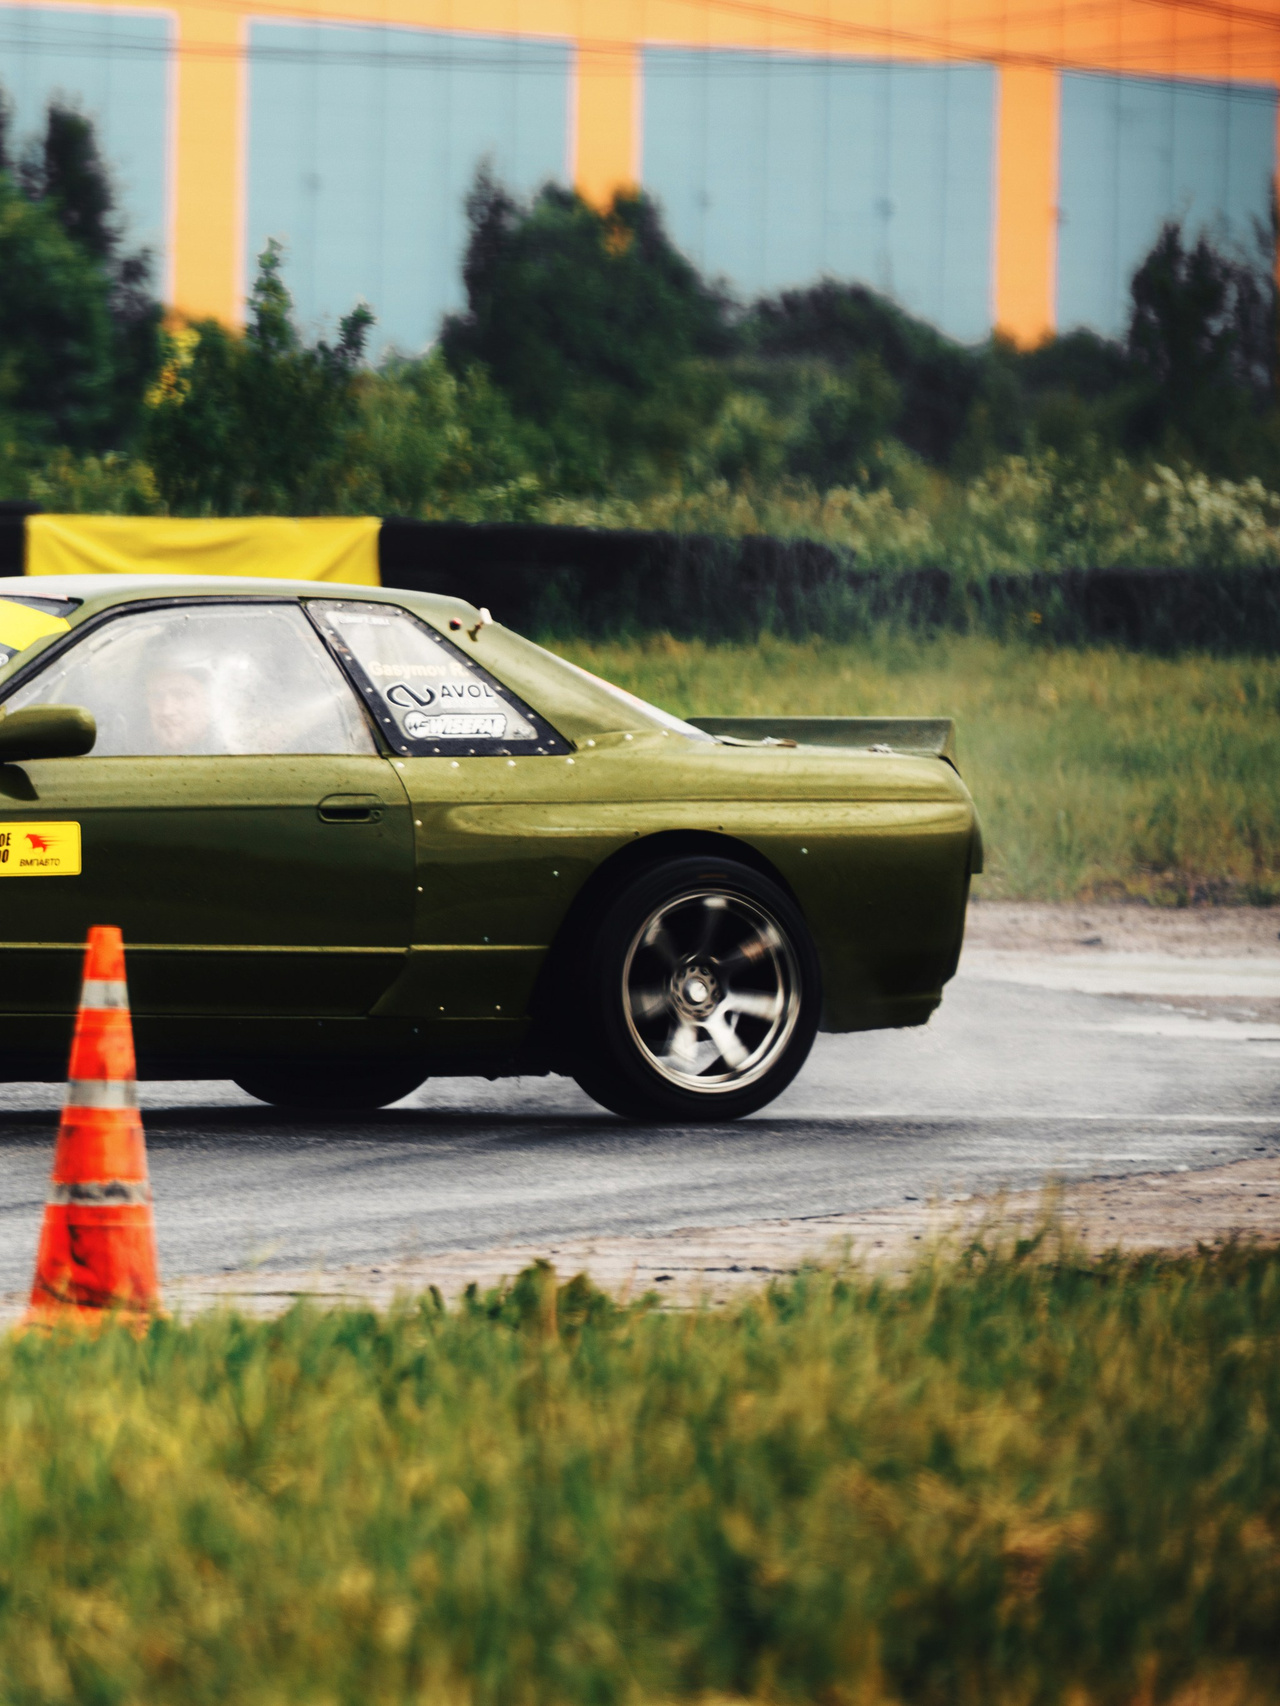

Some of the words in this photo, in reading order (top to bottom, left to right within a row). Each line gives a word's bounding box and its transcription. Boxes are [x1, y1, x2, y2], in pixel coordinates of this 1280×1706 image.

[367, 661, 446, 679] Gasymov
[448, 662, 470, 676] R.
[441, 684, 494, 698] AVOL
